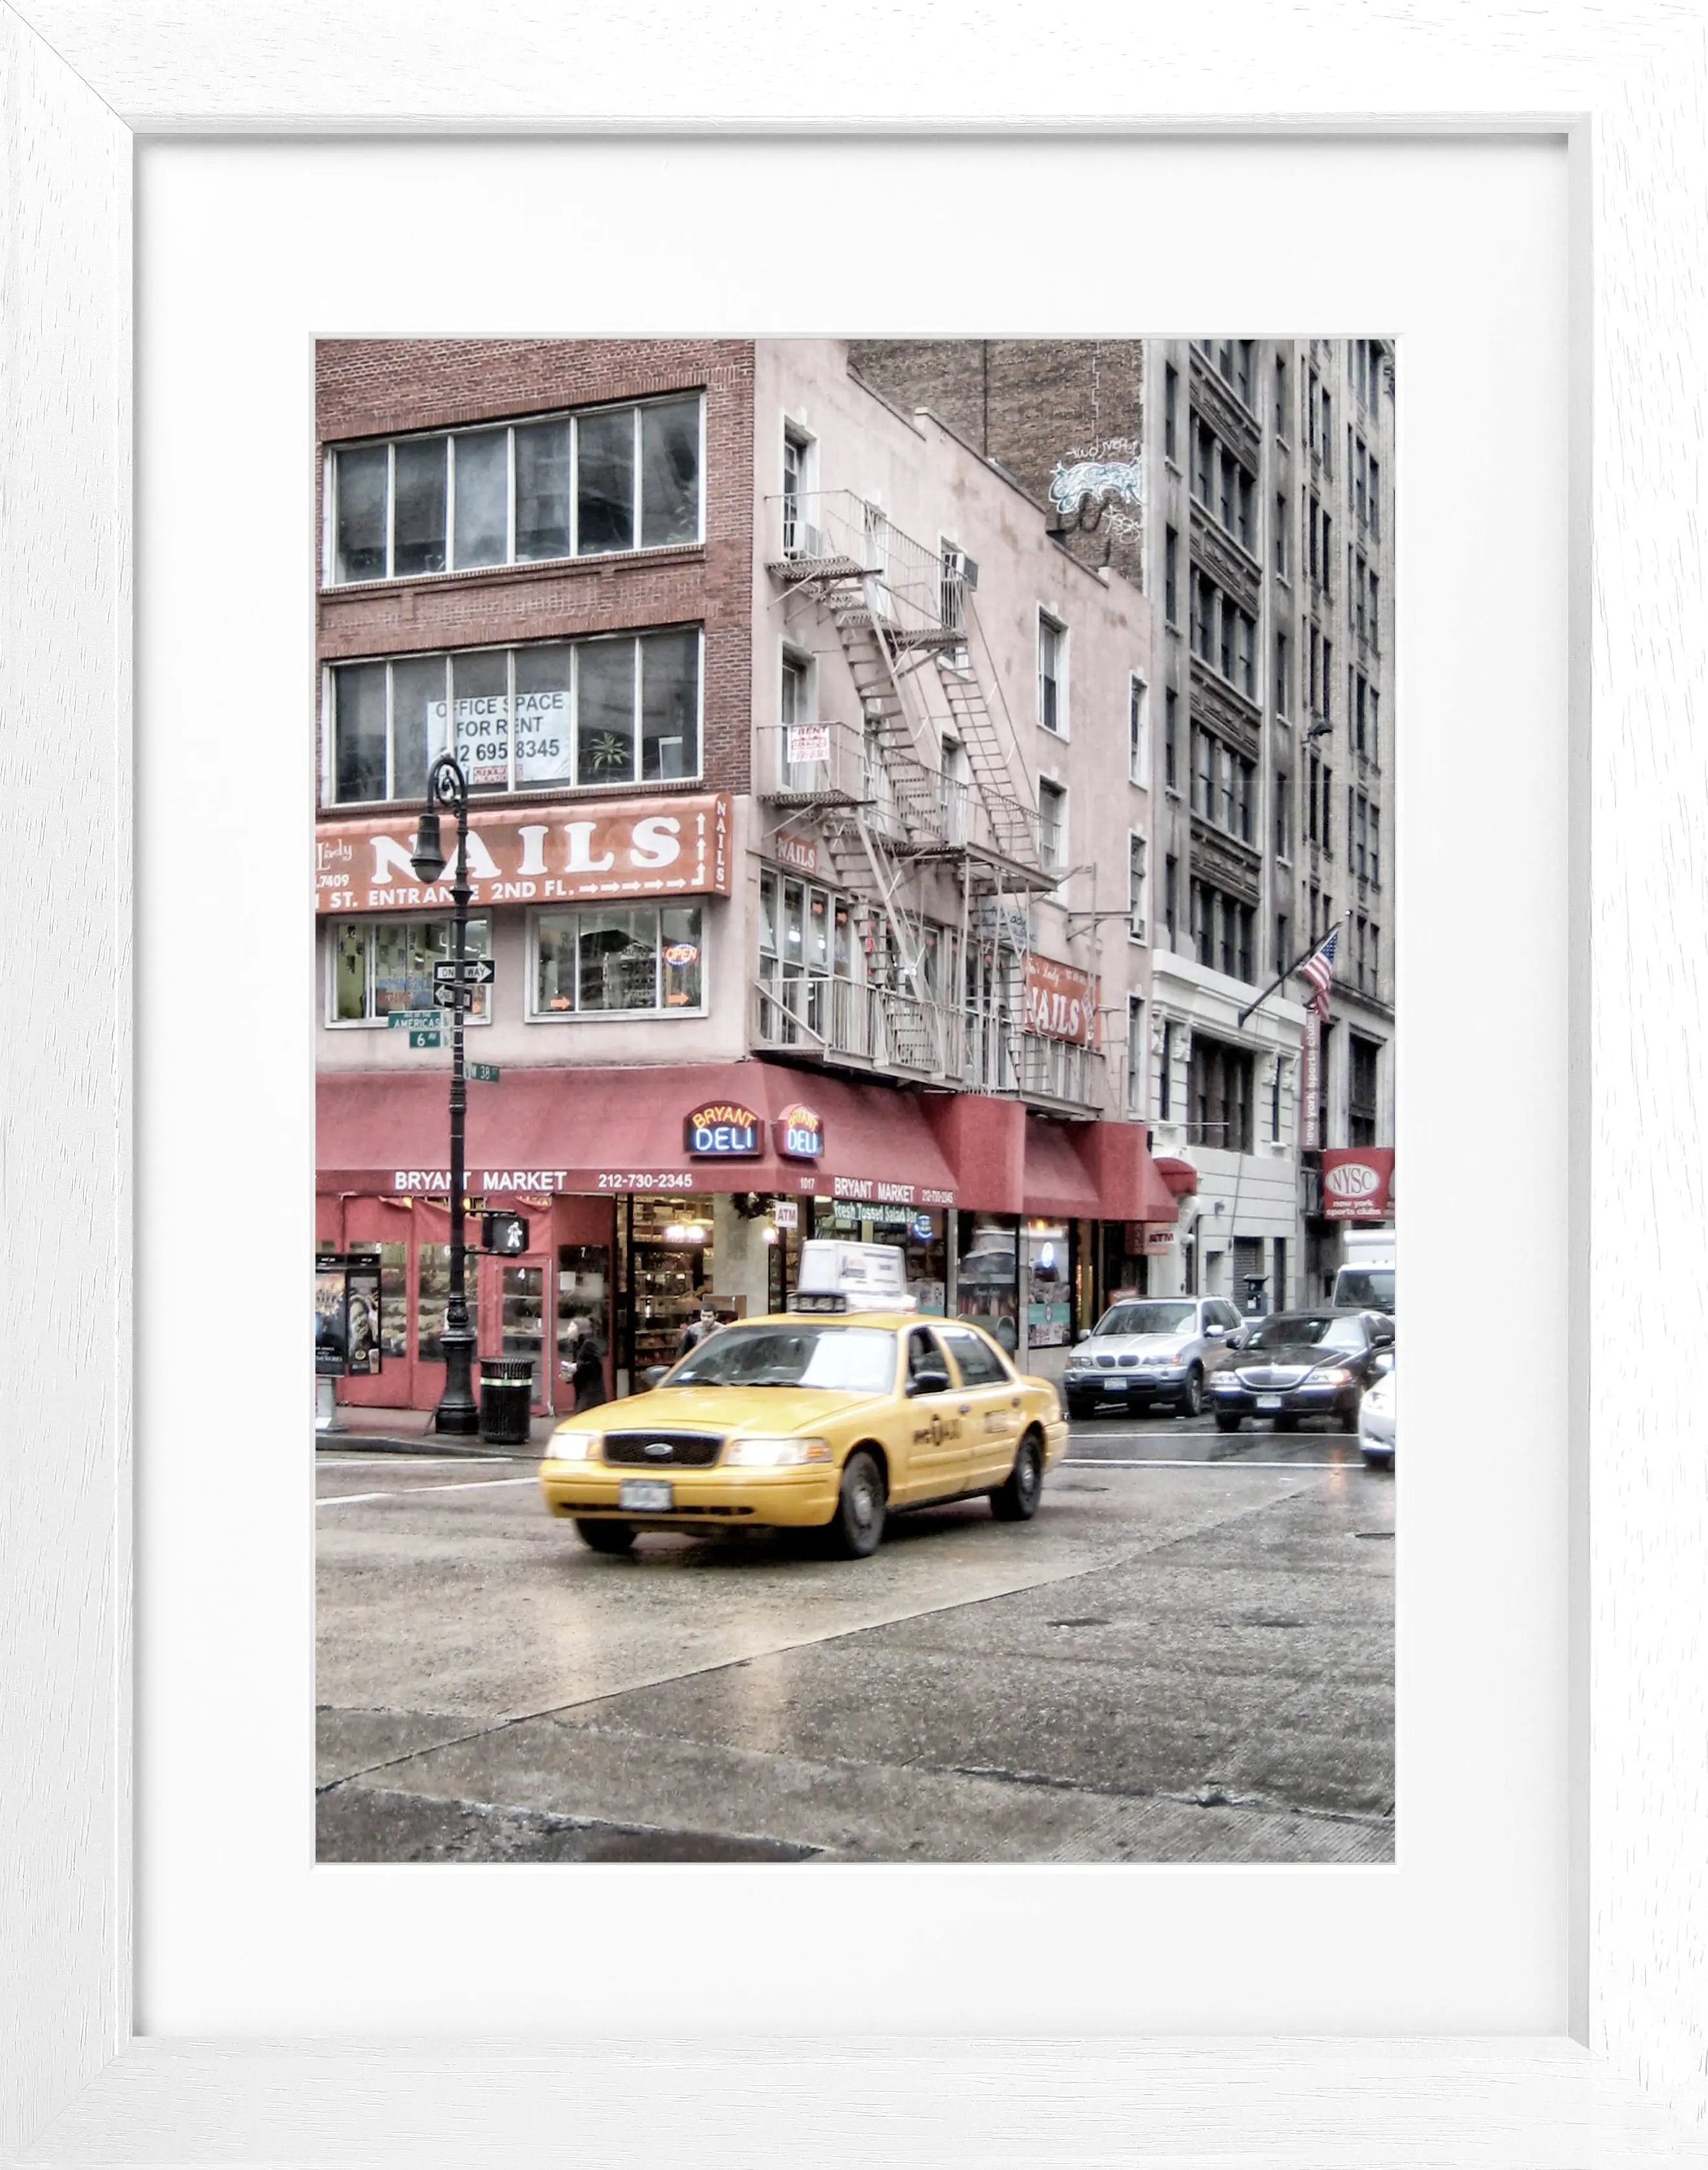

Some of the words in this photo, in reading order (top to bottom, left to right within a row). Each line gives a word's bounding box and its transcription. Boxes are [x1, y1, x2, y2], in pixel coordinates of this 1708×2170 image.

[456, 720, 491, 738] FOR
[476, 742, 508, 761] 695
[516, 739, 560, 759] 8345
[716, 800, 727, 882] NAILS
[370, 817, 681, 885] NAILS
[777, 837, 816, 869] NAILS
[330, 891, 358, 908] ST.
[369, 883, 480, 906] ENTRANE
[491, 880, 536, 900] 2ND
[545, 879, 575, 897] FL.
[665, 948, 698, 960] OPEN
[442, 965, 455, 978] ON
[467, 965, 485, 978] WAY
[394, 1018, 441, 1029] AMERICAS
[417, 1032, 426, 1047] 6
[480, 1065, 490, 1080] 38
[692, 1106, 757, 1129] BRYANT
[695, 1126, 752, 1151] DELI
[787, 1128, 817, 1153] DELI
[483, 1171, 567, 1190] MARKET
[598, 1173, 693, 1188] 212-730-2345
[1332, 1167, 1373, 1194] NYSC
[800, 1177, 816, 1190] 1017
[834, 1177, 873, 1199] BRYANT
[877, 1183, 915, 1203] MARKET
[833, 1200, 855, 1219] Fresh
[857, 1203, 883, 1222] Tossed
[1326, 1208, 1355, 1217] sports
[1353, 1200, 1373, 1209] york
[777, 1208, 797, 1223] ATM
[1149, 1233, 1174, 1243] ATM
[374, 1242, 382, 1253] 5
[518, 1268, 526, 1280] 4
